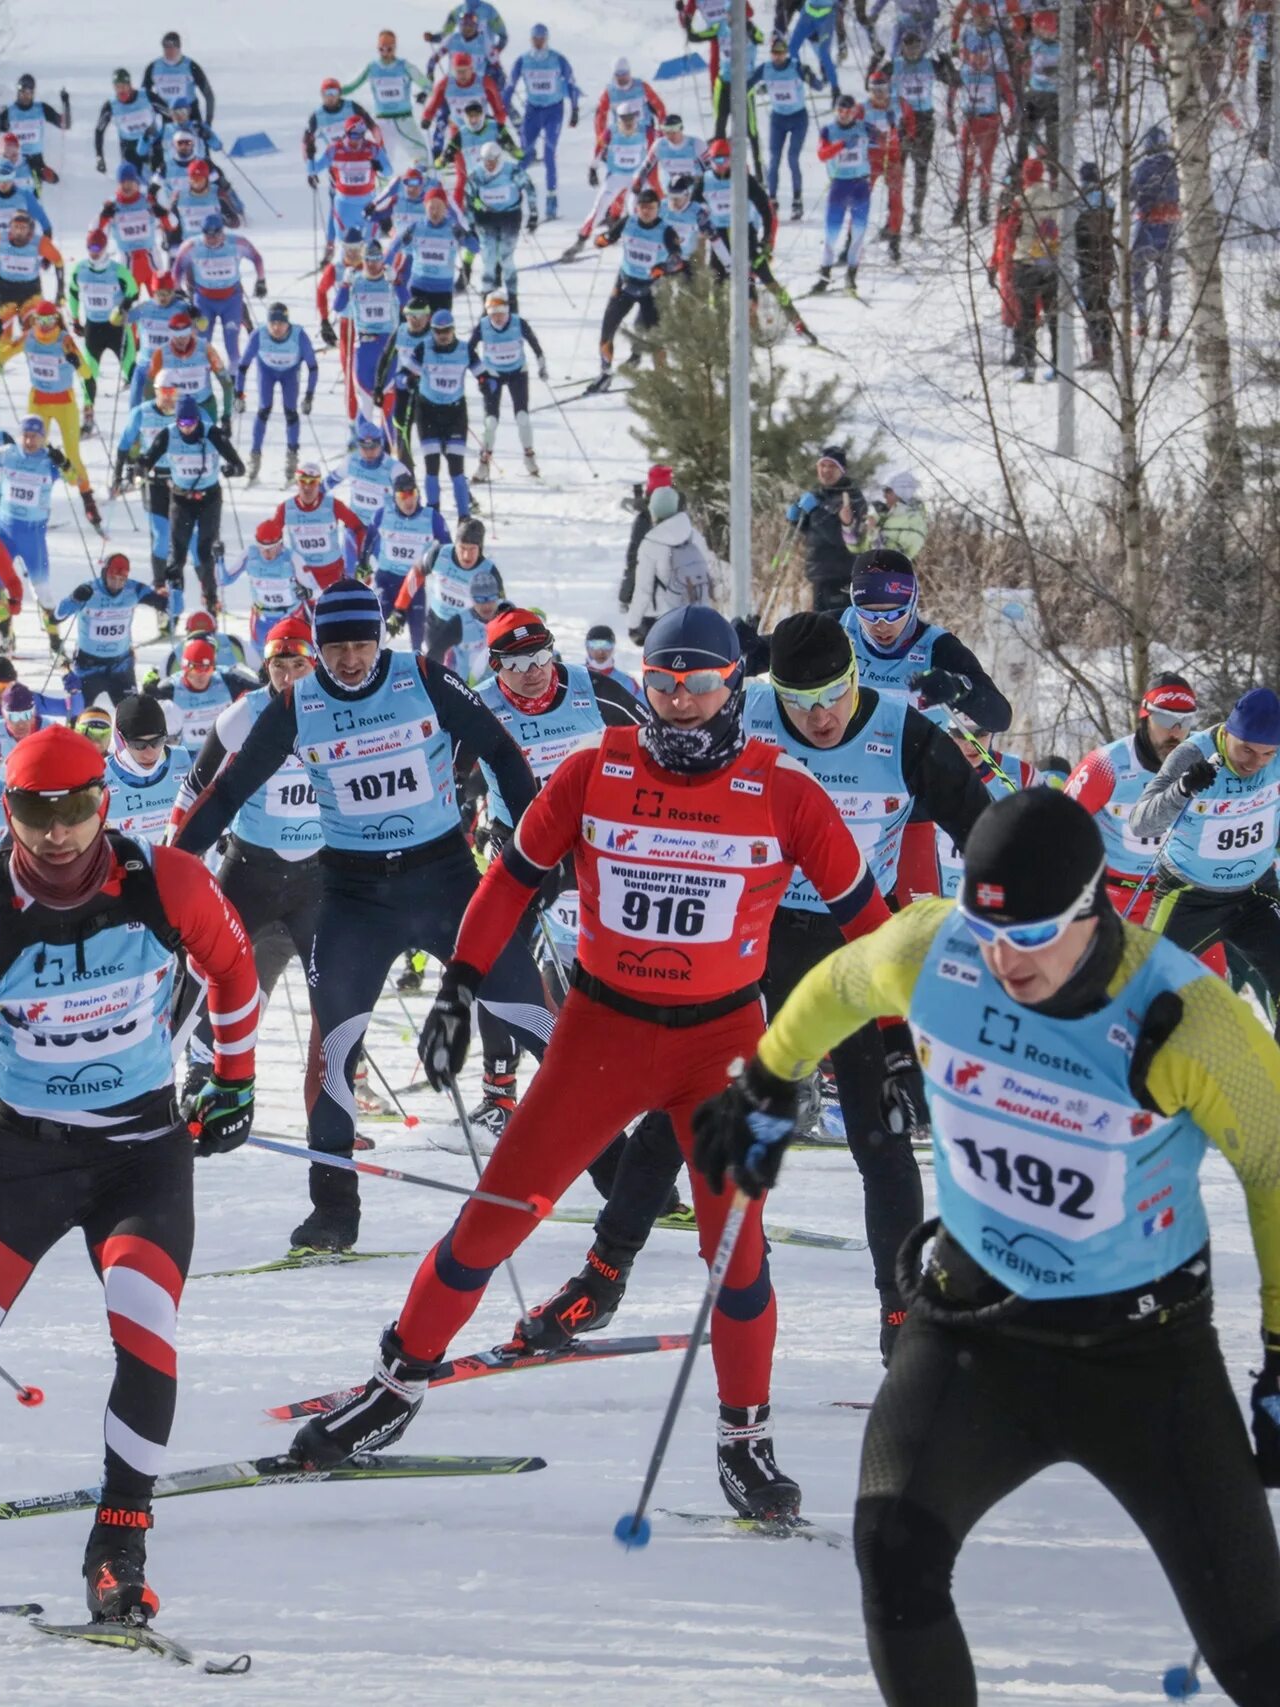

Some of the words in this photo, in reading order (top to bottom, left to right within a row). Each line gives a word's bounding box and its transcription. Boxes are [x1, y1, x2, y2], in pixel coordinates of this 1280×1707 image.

[443, 673, 474, 701] CRAFT
[358, 711, 397, 728] Rostec
[543, 723, 577, 737] Rostec
[866, 743, 879, 754] 50
[604, 765, 617, 774] 50
[344, 767, 418, 803] 1074
[731, 780, 745, 791] 50
[667, 807, 721, 825] Rostec
[652, 833, 698, 848] Demino
[1216, 820, 1265, 852] 953
[647, 847, 717, 863] marathon
[610, 865, 684, 884] WORLDLOPPET
[684, 874, 727, 889] MASTER
[623, 878, 668, 895] Gordeev
[668, 886, 711, 899] Aleksey
[621, 890, 707, 938] 916
[616, 960, 693, 981] RYBINSK
[942, 963, 957, 977] 50
[62, 992, 108, 1011] Demino
[62, 998, 130, 1024] marathon
[1023, 1046, 1095, 1081] Rostec
[45, 1076, 126, 1097] RYBINSK
[1000, 1076, 1060, 1107] Demino
[221, 1114, 250, 1138] LEKI
[994, 1097, 1084, 1134] marathon
[951, 1136, 1097, 1223] 1192
[980, 1237, 1078, 1285] RYBINSK
[255, 1471, 331, 1488] FISCHER
